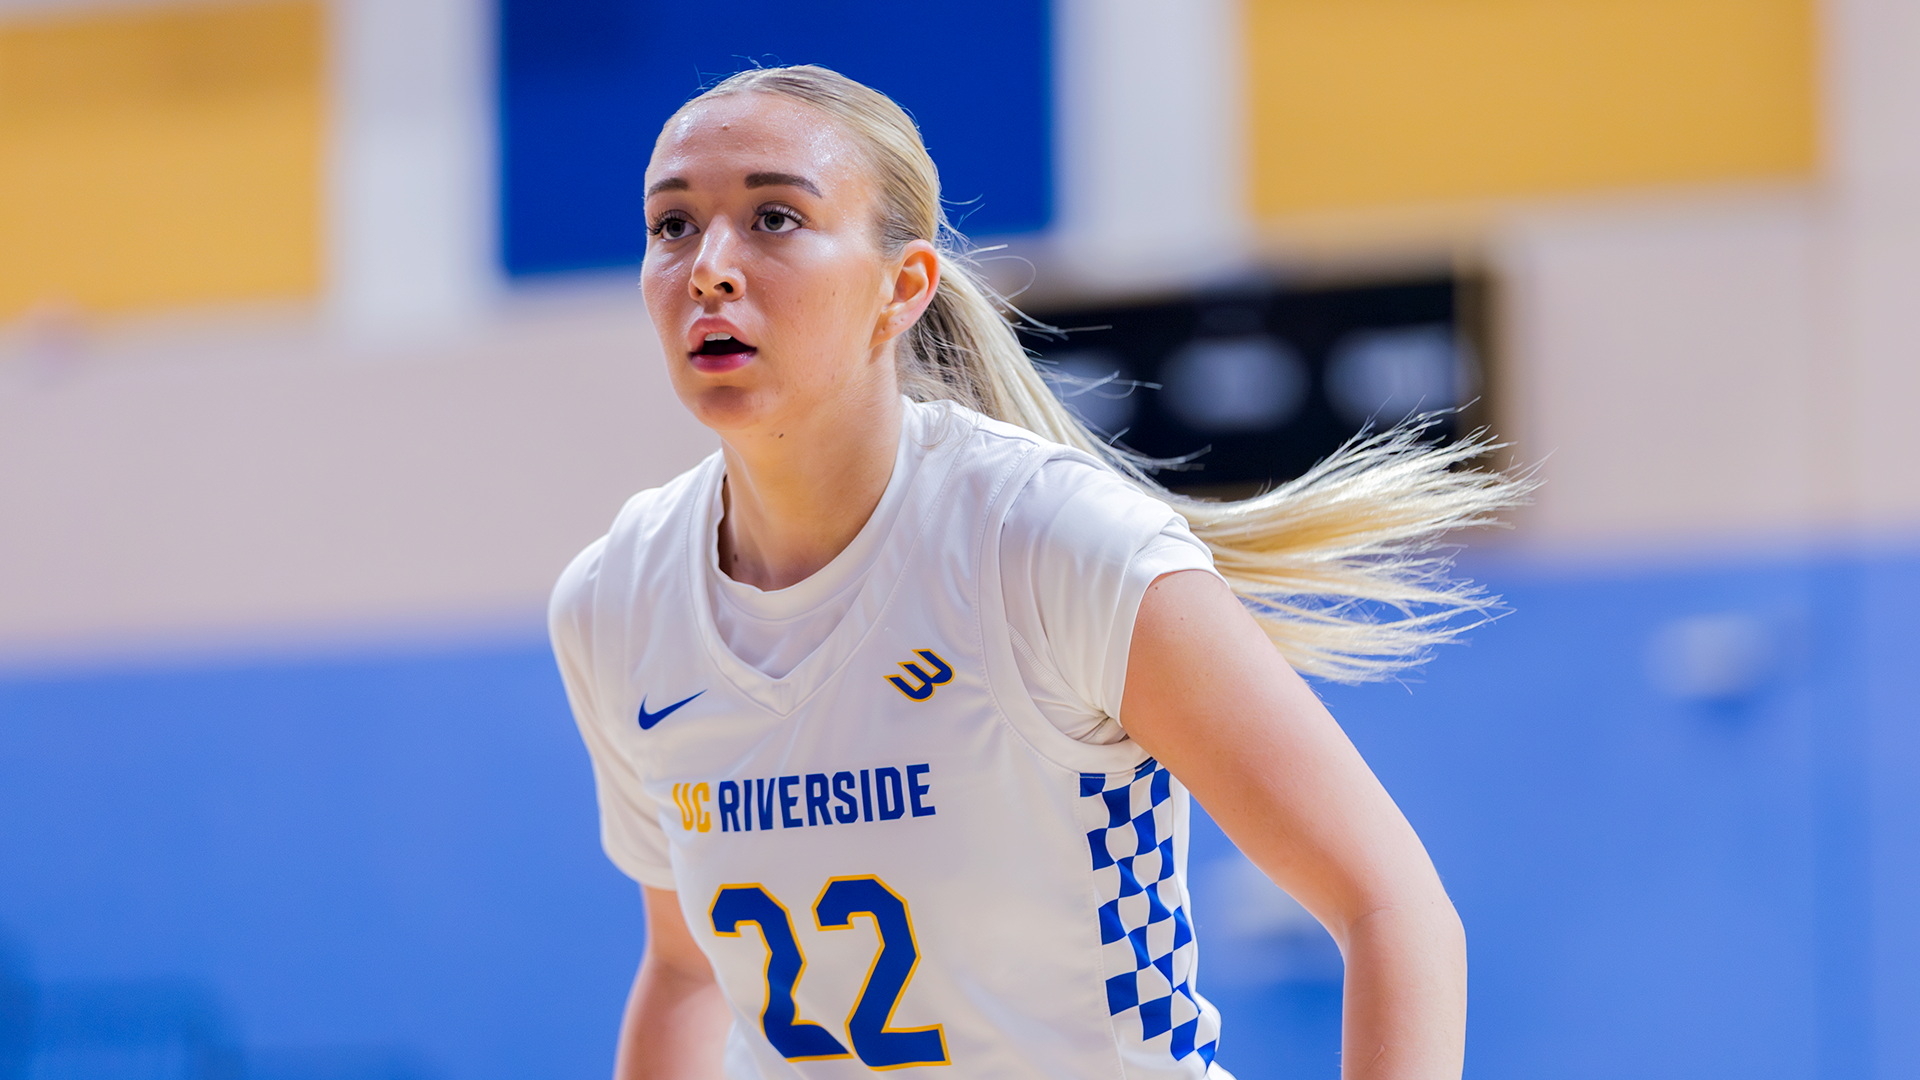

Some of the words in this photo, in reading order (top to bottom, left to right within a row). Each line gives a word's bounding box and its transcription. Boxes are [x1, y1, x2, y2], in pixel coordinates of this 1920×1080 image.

[672, 782, 712, 833] UC
[718, 763, 936, 832] RIVERSIDE
[708, 874, 952, 1071] 22
